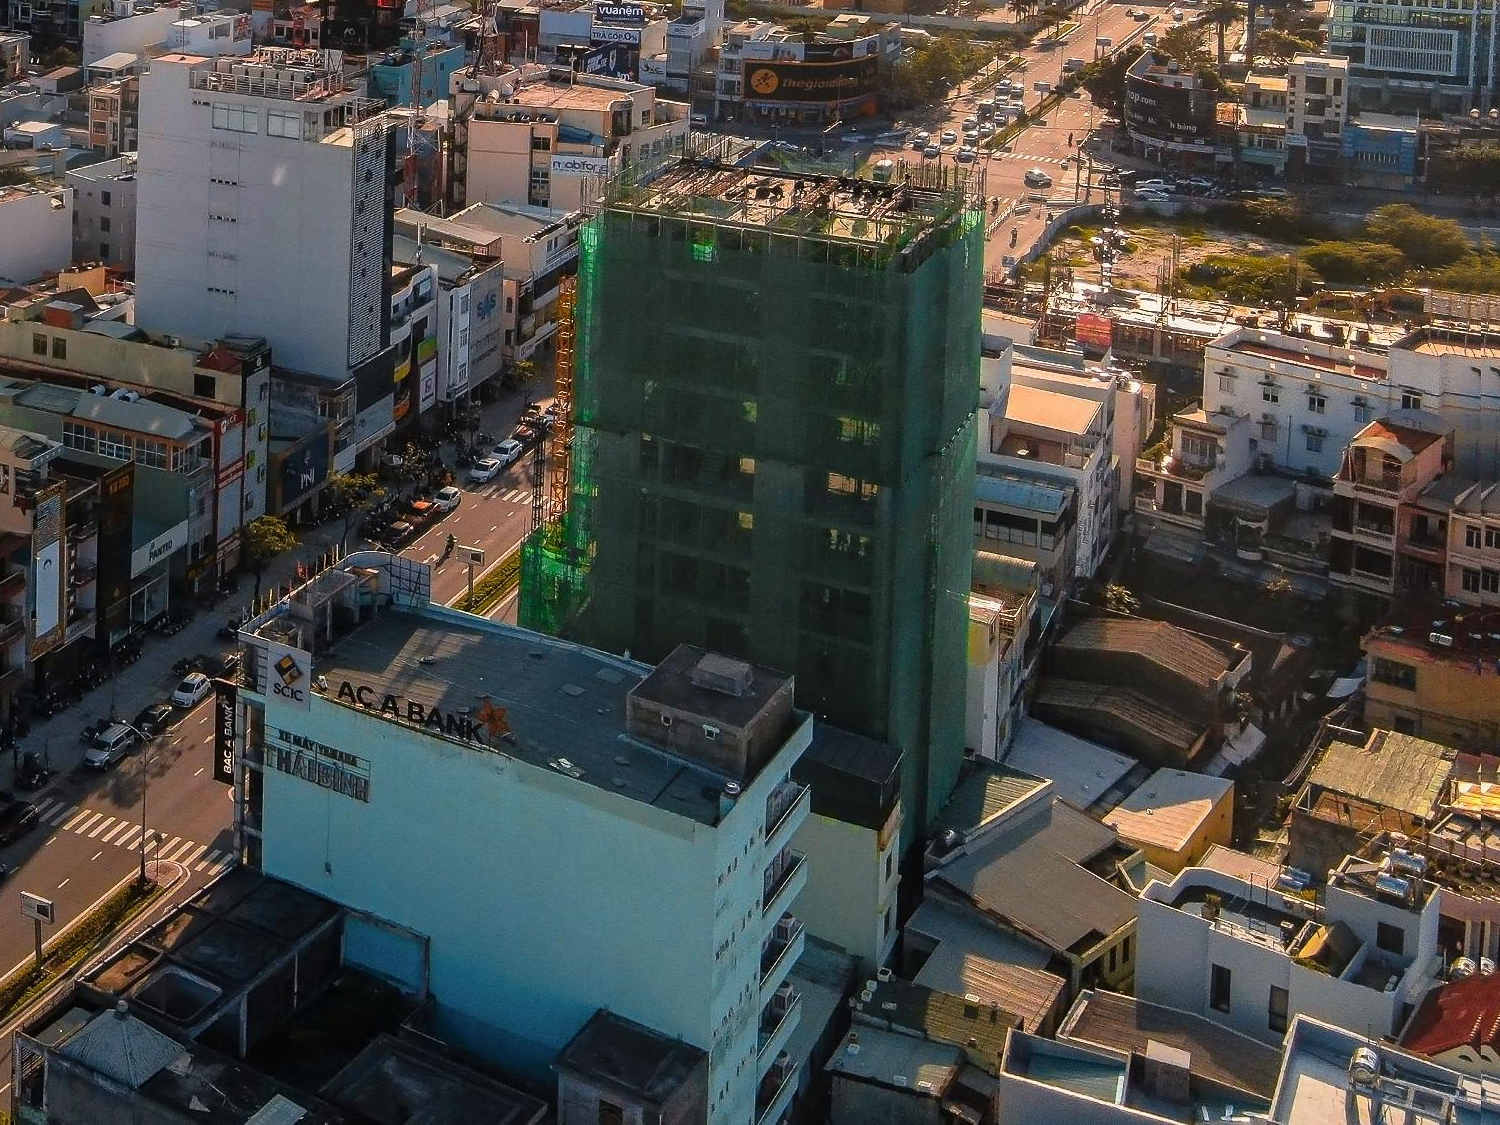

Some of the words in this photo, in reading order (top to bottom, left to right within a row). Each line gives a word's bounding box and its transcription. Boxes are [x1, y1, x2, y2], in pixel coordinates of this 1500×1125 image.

[272, 682, 304, 703] SCIC
[224, 705, 233, 736] BANK
[406, 698, 486, 745] BANK
[223, 749, 232, 774] BAC
